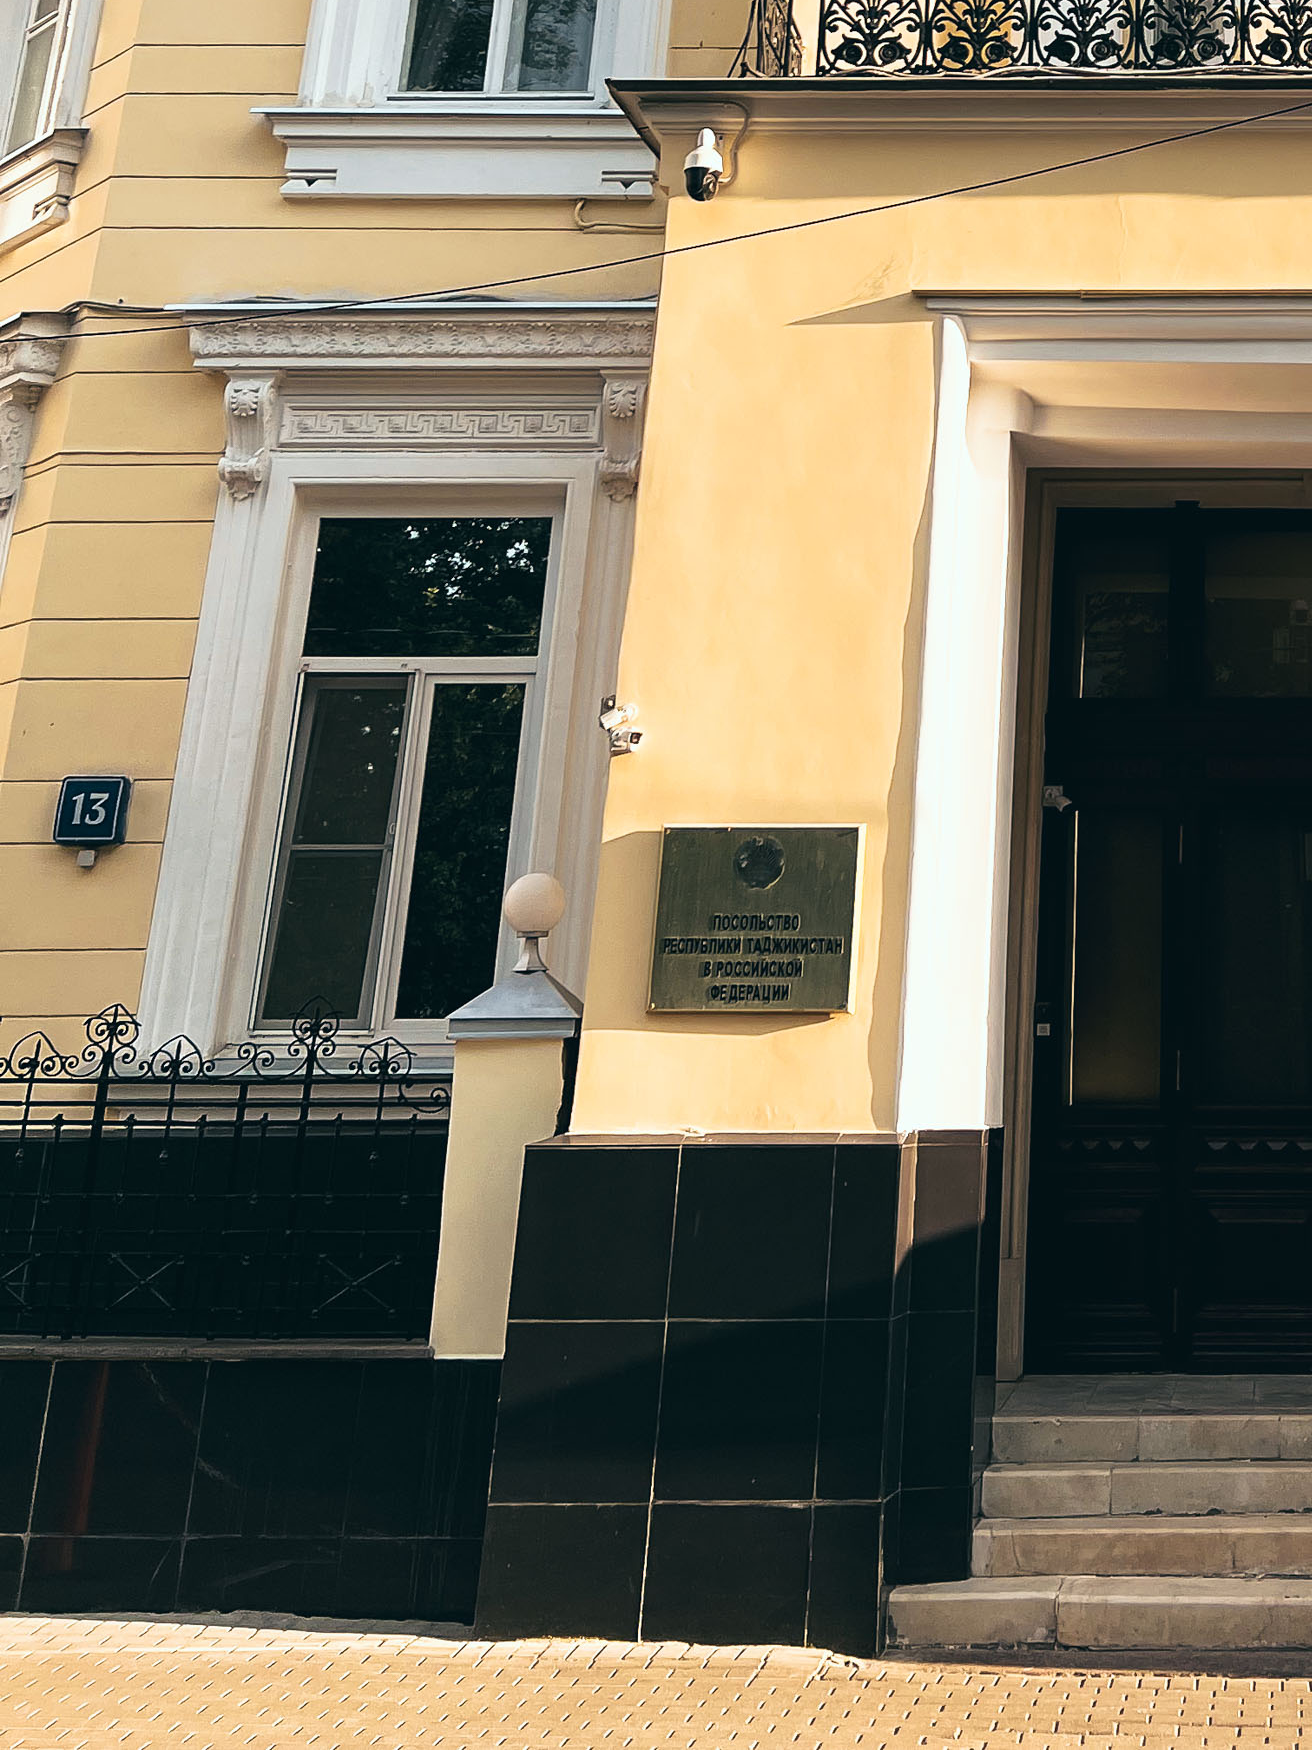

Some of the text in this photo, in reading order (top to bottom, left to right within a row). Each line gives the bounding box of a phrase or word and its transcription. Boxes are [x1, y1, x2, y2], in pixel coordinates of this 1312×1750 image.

[72, 792, 110, 825] 13
[711, 914, 800, 931] ПОСОЛЬСТВО
[662, 936, 844, 956] РЕСПУБЛИКИ ТАДЖИКИСТАН
[703, 958, 804, 978] В РОССИЙСКОЙ
[709, 984, 791, 1003] ФЕДЕРАЦИИ
